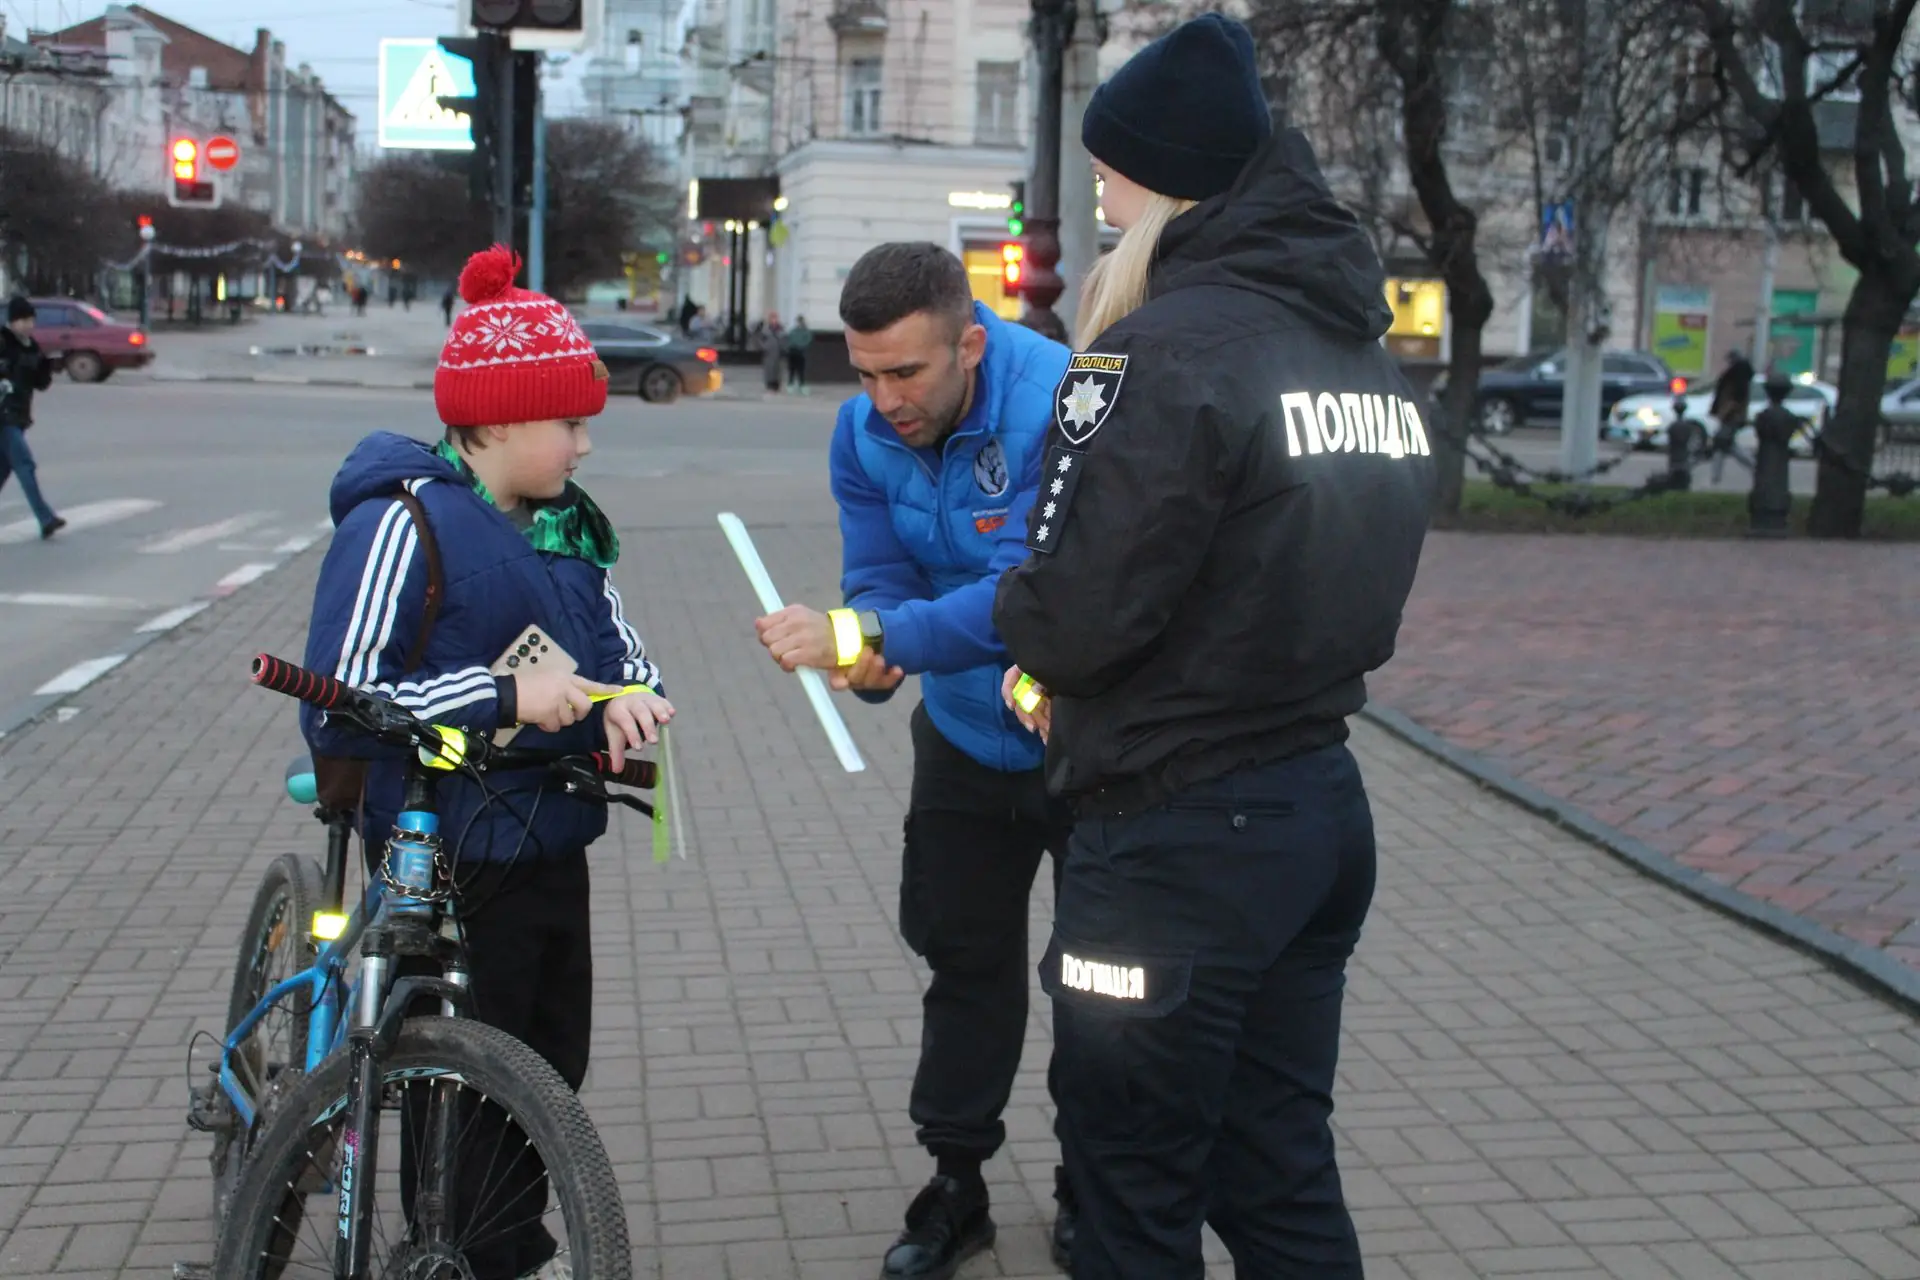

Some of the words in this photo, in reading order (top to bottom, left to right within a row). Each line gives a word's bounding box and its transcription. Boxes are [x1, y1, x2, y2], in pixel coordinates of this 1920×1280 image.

[1074, 356, 1122, 370] ПОЛІЦІЯ
[1281, 392, 1430, 458] ПОЛІЦІЯ
[339, 1143, 354, 1239] FORT
